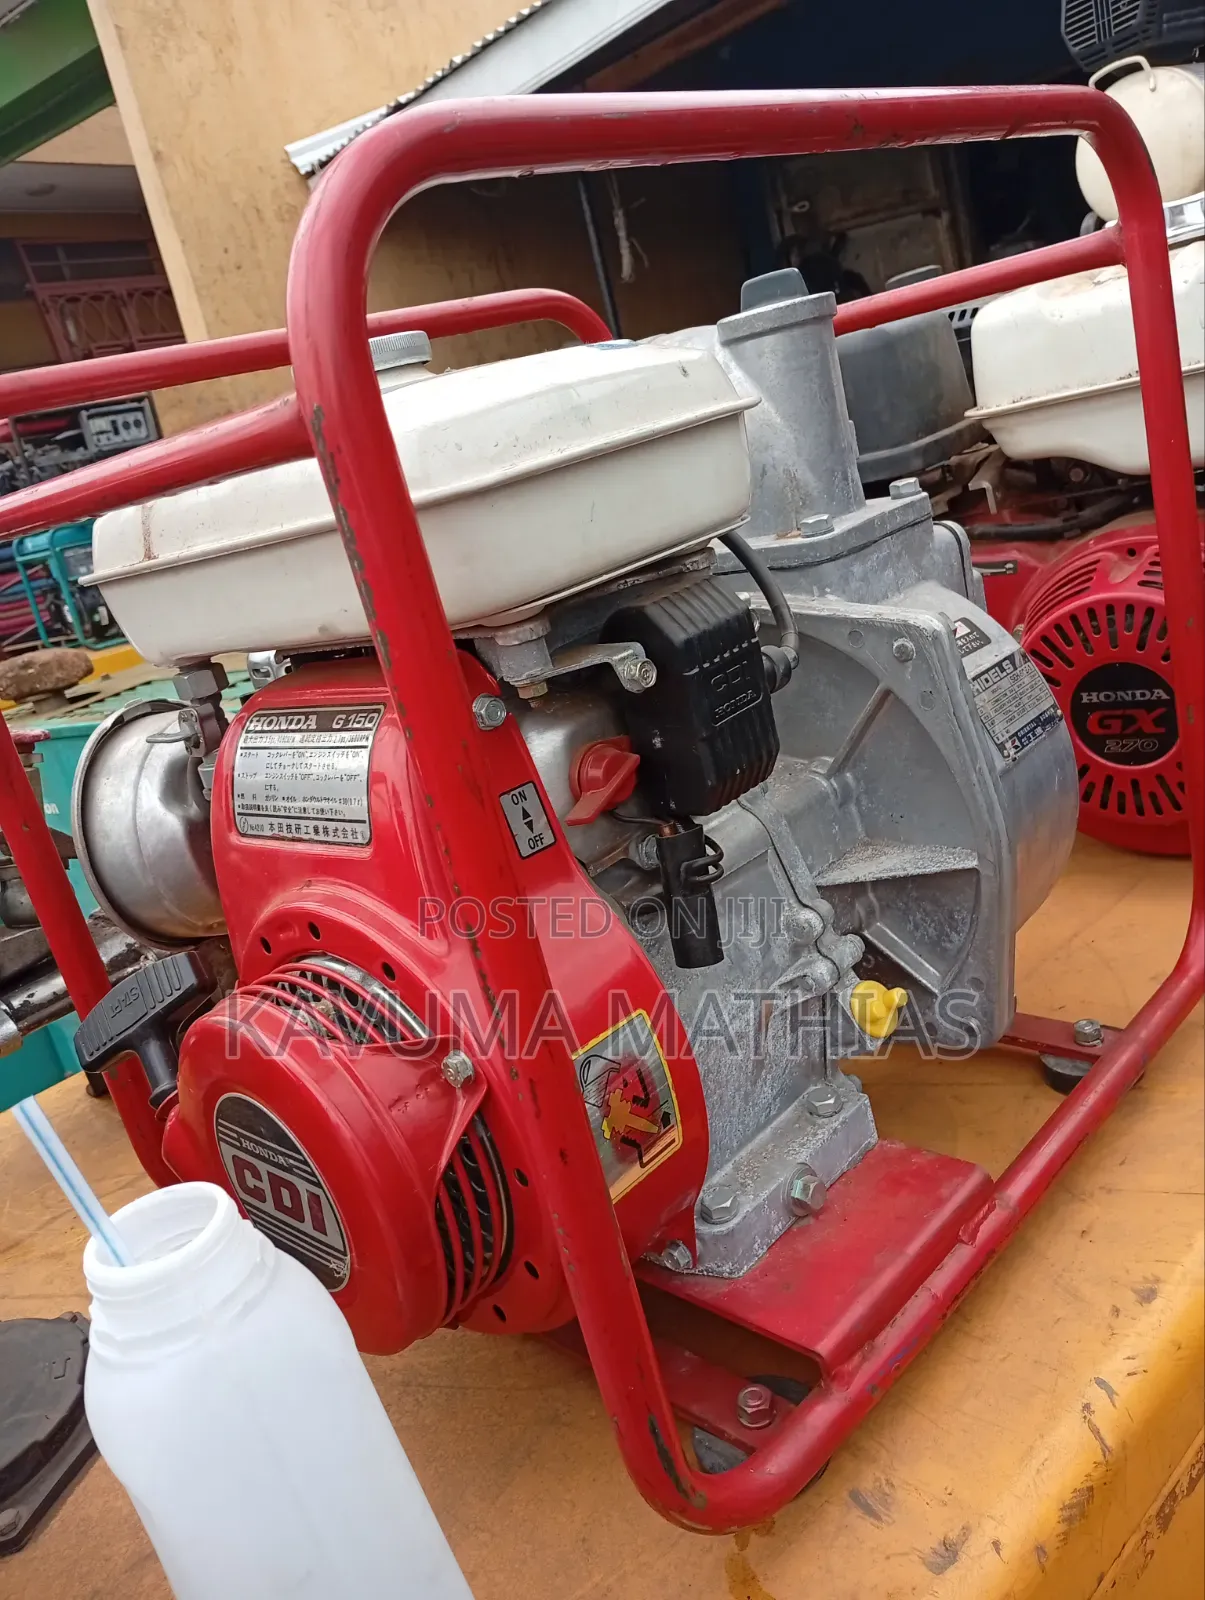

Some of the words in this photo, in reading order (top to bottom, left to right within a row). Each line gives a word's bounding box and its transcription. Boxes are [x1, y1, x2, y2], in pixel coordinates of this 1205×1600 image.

[1080, 689, 1171, 704] HONDA
[248, 715, 317, 731] HONDA
[1086, 706, 1169, 736] GX
[1104, 737, 1159, 753] 270
[511, 789, 527, 806] ON
[268, 821, 358, 840] 本田技研工業株式会社
[527, 833, 544, 850] OFF
[239, 1137, 290, 1168] HONDA
[232, 1154, 328, 1236] CDI
